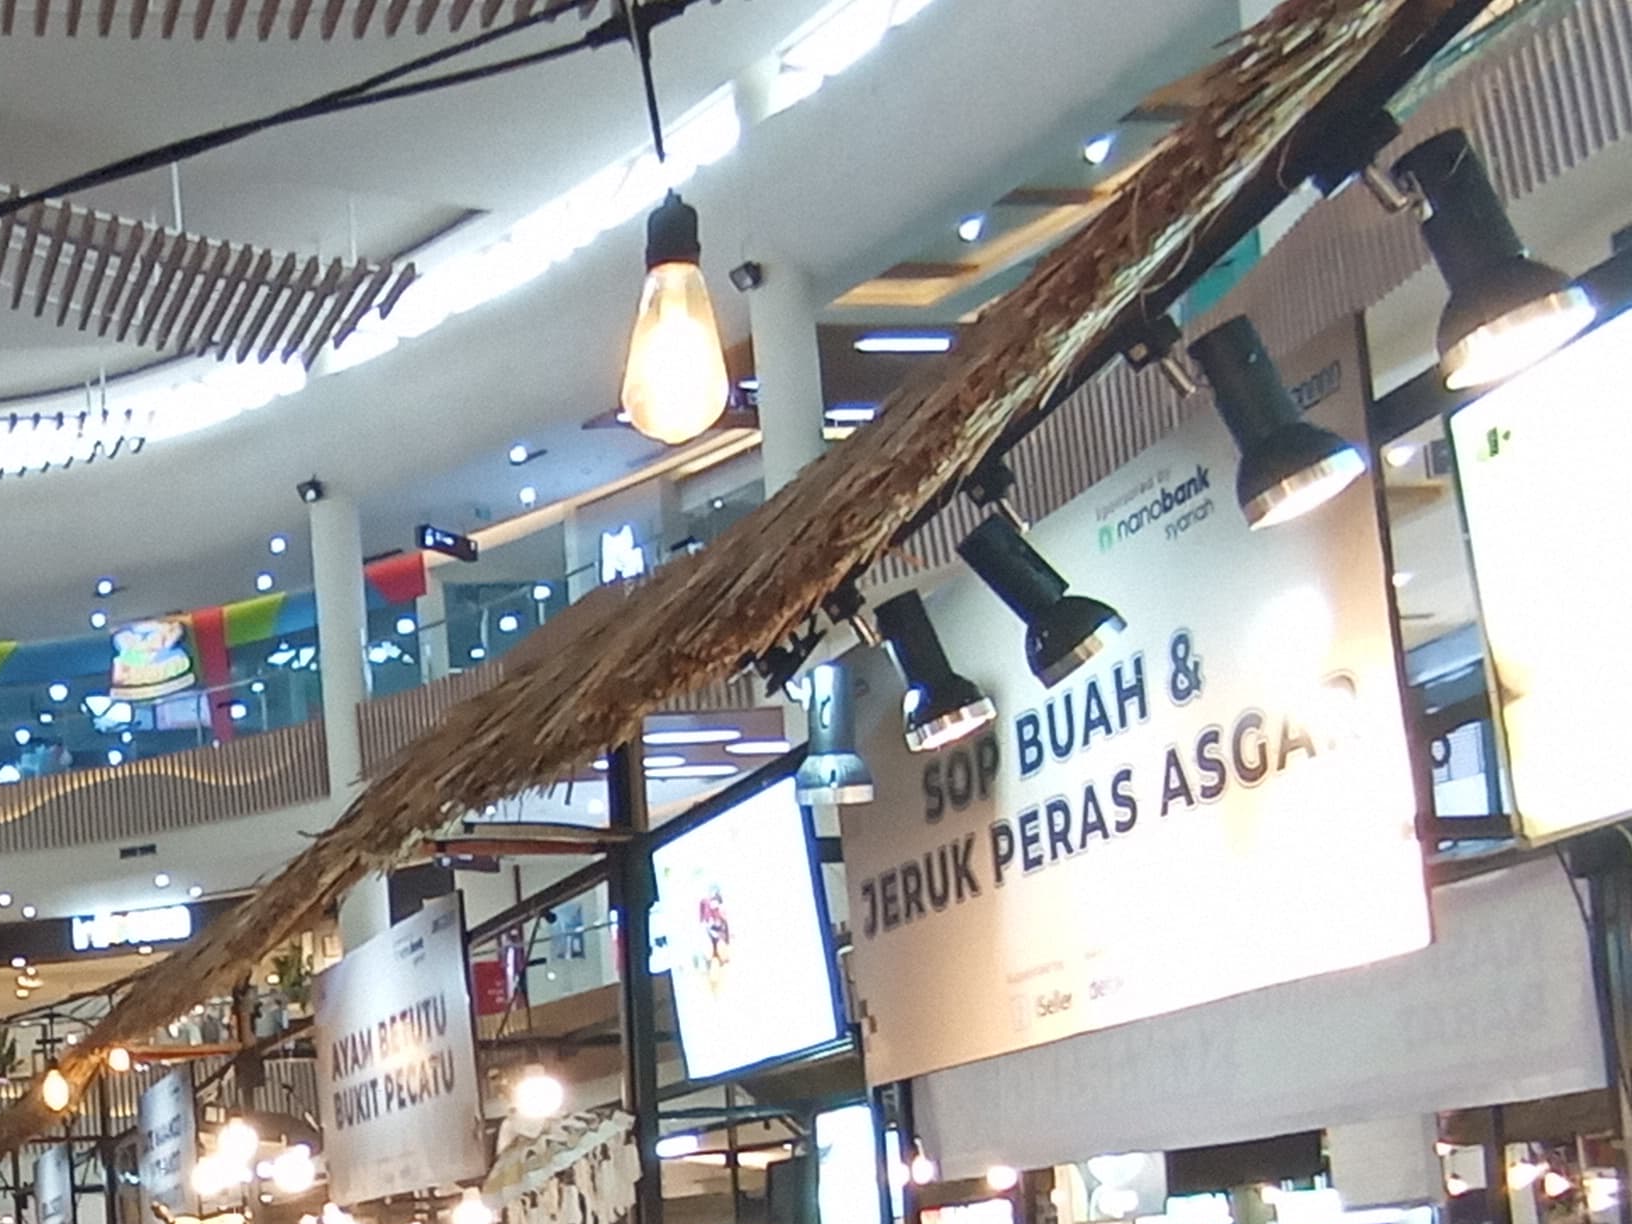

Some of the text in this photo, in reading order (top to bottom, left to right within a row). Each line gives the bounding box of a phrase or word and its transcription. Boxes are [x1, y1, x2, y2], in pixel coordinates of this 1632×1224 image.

[1116, 464, 1210, 539] nanobank
[922, 631, 1202, 826] SOP BUAH &
[861, 832, 980, 939] JERUK
[989, 767, 1138, 886] PERAS
[331, 1025, 374, 1082] AYAM
[333, 1076, 380, 1131] BUKIT
